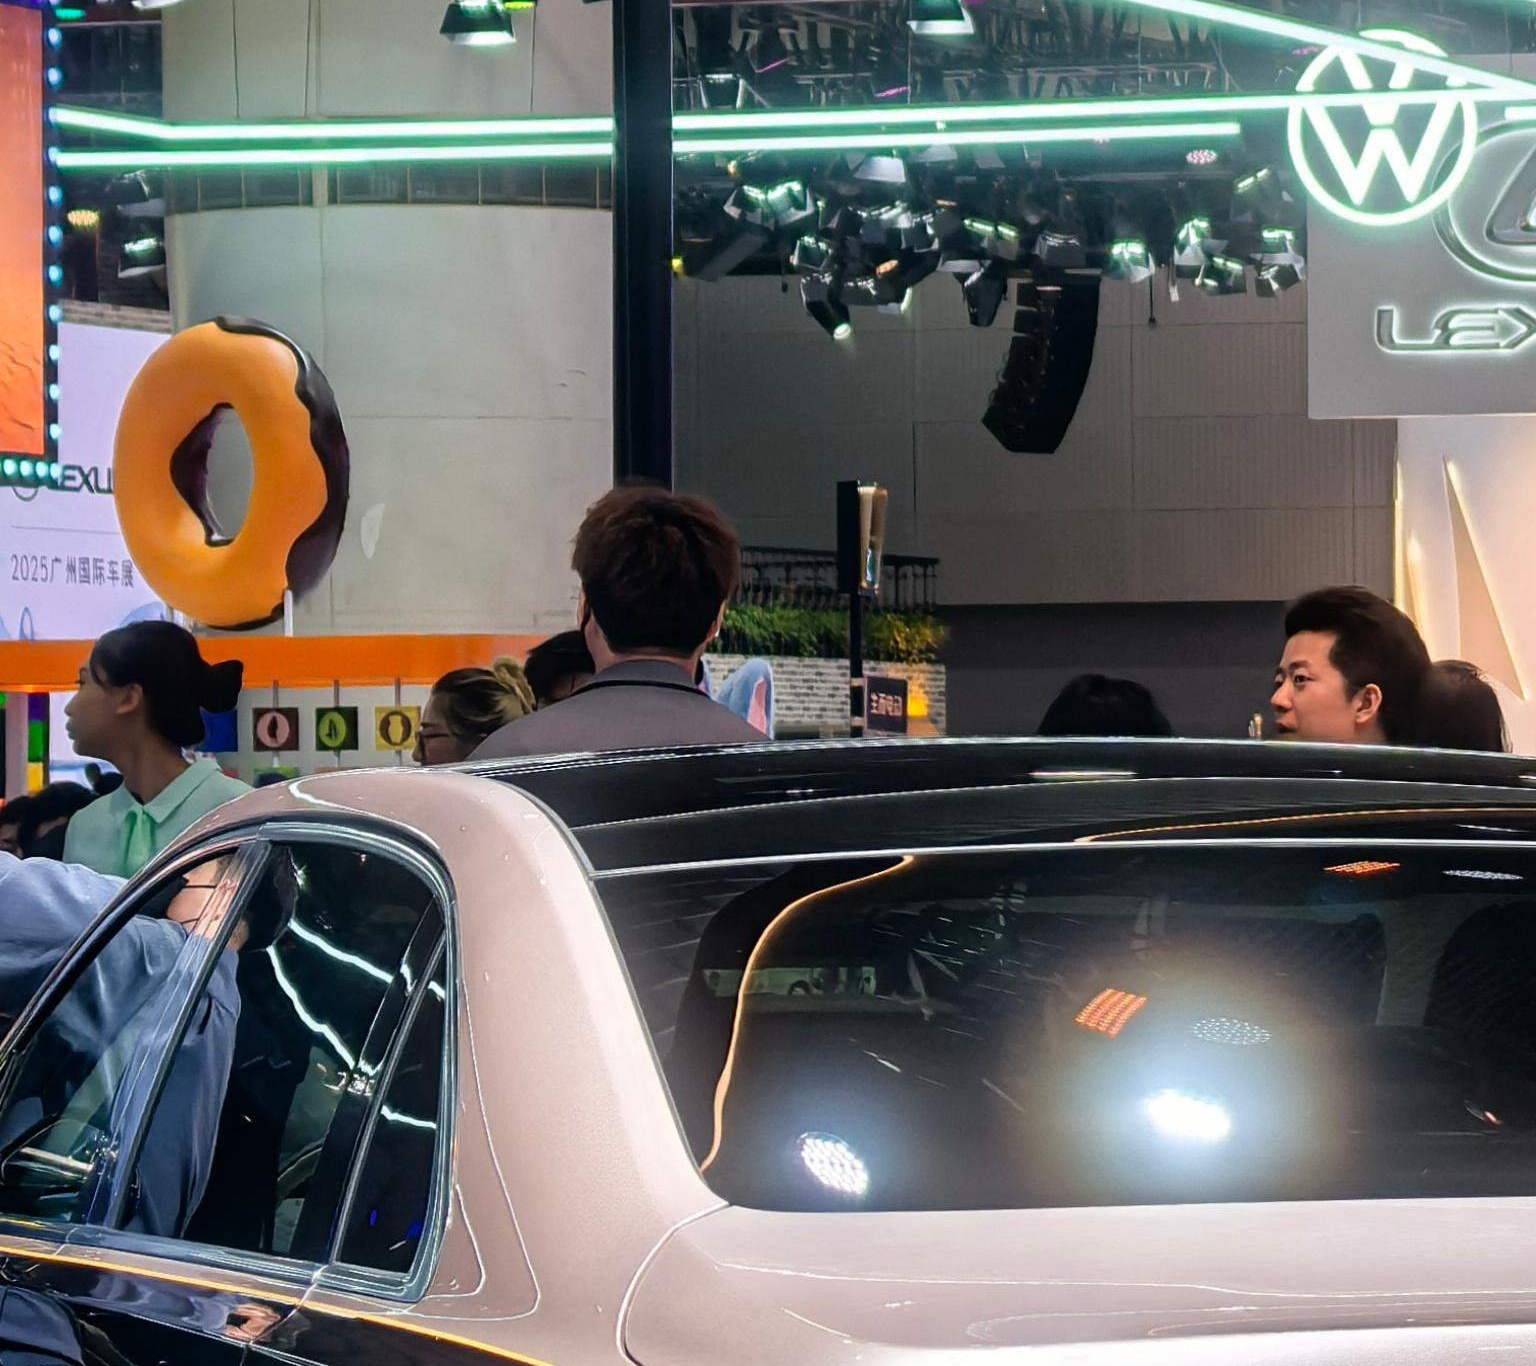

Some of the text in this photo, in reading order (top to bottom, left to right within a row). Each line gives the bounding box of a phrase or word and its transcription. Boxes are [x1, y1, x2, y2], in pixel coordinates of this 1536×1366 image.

[10, 553, 135, 588] 2025广州国际车展
